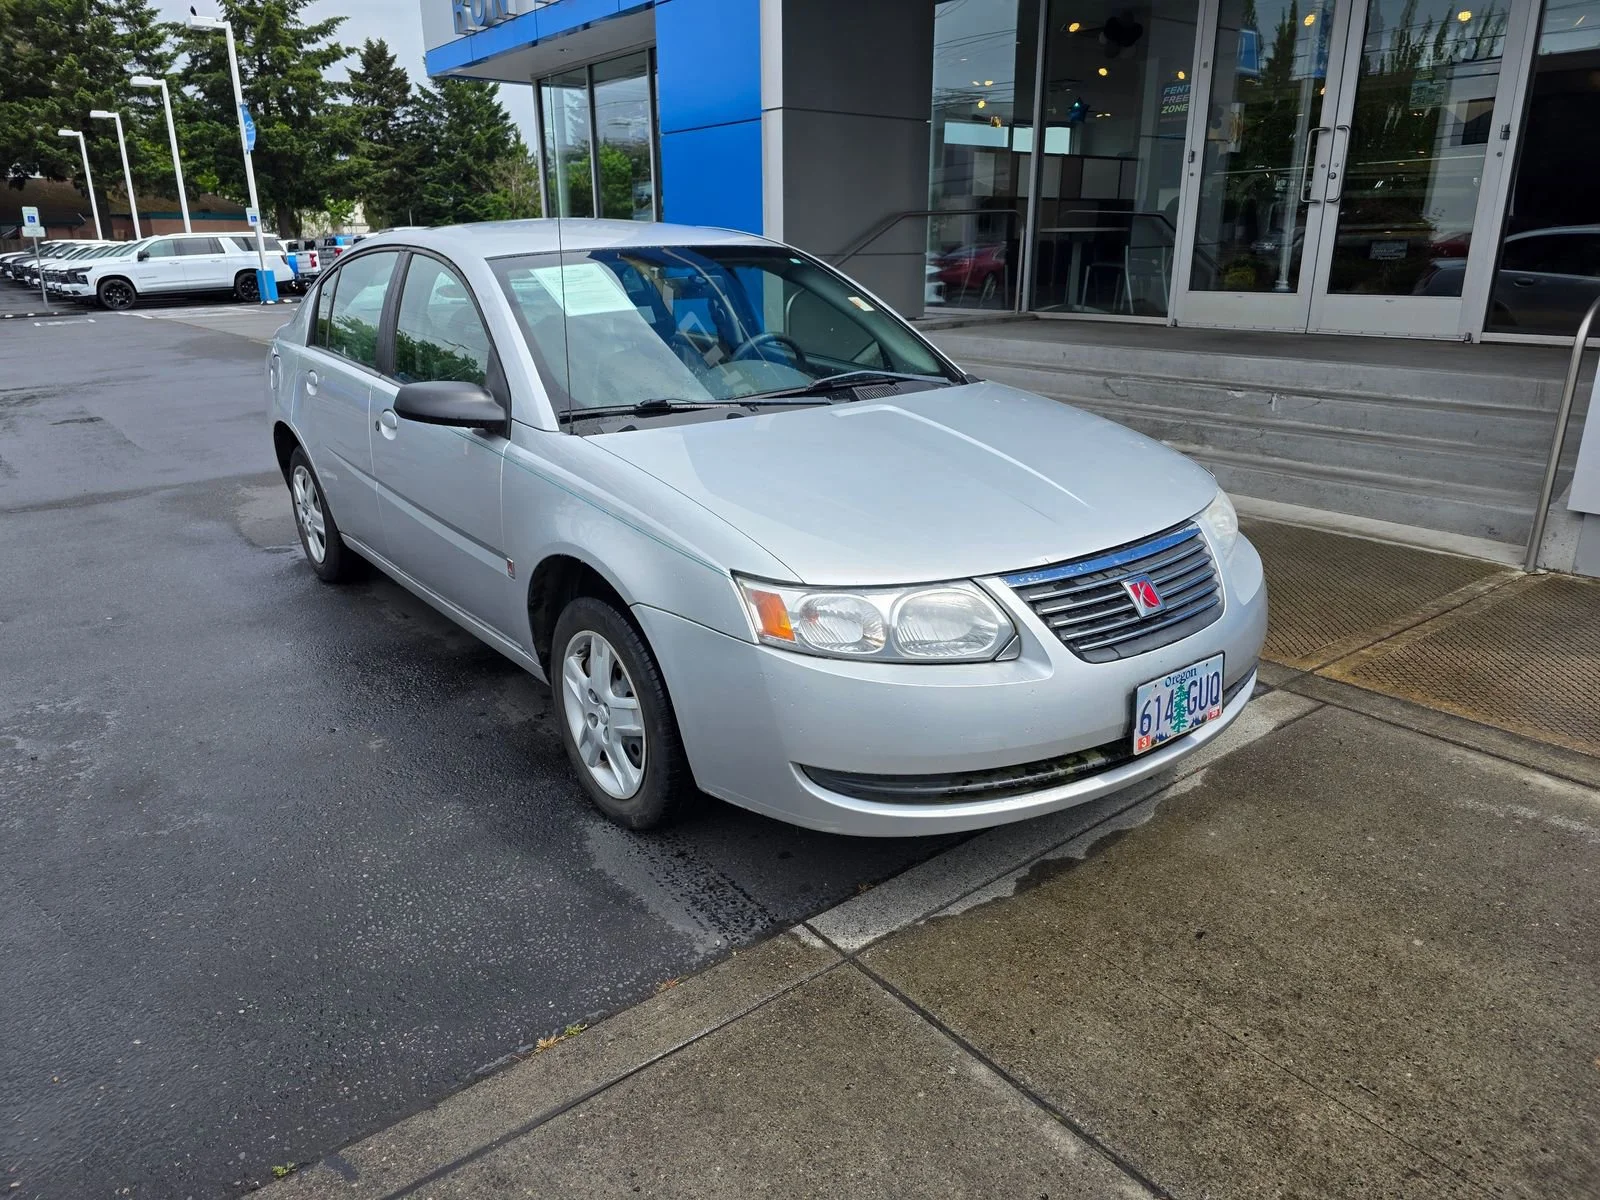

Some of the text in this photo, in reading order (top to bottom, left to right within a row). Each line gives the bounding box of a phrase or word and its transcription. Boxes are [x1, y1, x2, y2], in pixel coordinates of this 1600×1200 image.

[1162, 94, 1190, 104] FREE
[1161, 104, 1189, 114] ZONE
[1165, 667, 1197, 687] Oregon
[1140, 671, 1220, 736] 614 GUQ
